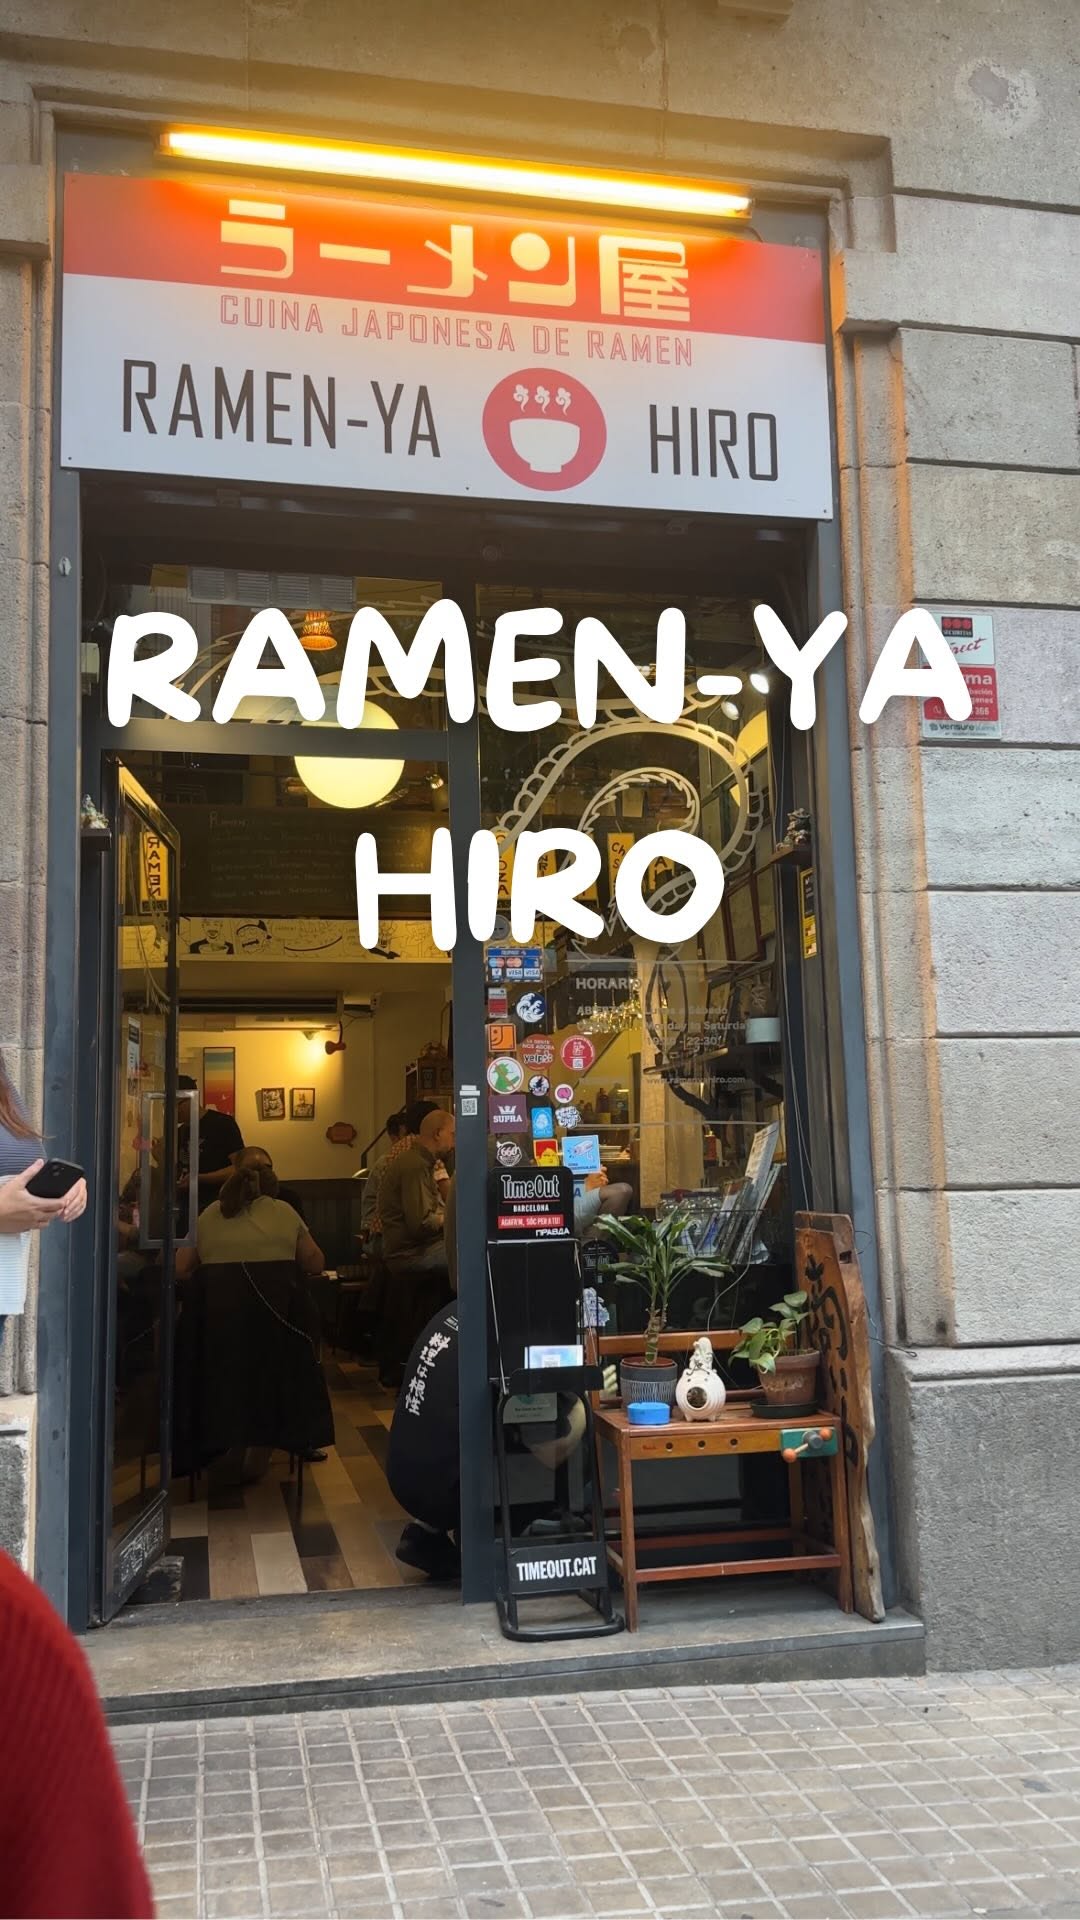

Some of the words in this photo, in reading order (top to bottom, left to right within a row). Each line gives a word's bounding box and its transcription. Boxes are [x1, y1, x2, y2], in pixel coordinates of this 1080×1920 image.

[220, 198, 691, 323] ラーメン屋
[220, 294, 324, 333] CUINA
[341, 307, 515, 351] JAPONESA
[532, 325, 570, 356] DE
[587, 330, 692, 367] RAMEN
[122, 358, 441, 458] RAMEN-YA
[648, 404, 779, 483] HIRO
[493, 1114, 522, 1123] SUPRA
[513, 1204, 549, 1212] BARCELONA
[535, 1227, 570, 1237] ПРАВДА
[516, 1556, 597, 1581] TIMEOUT.CAT
